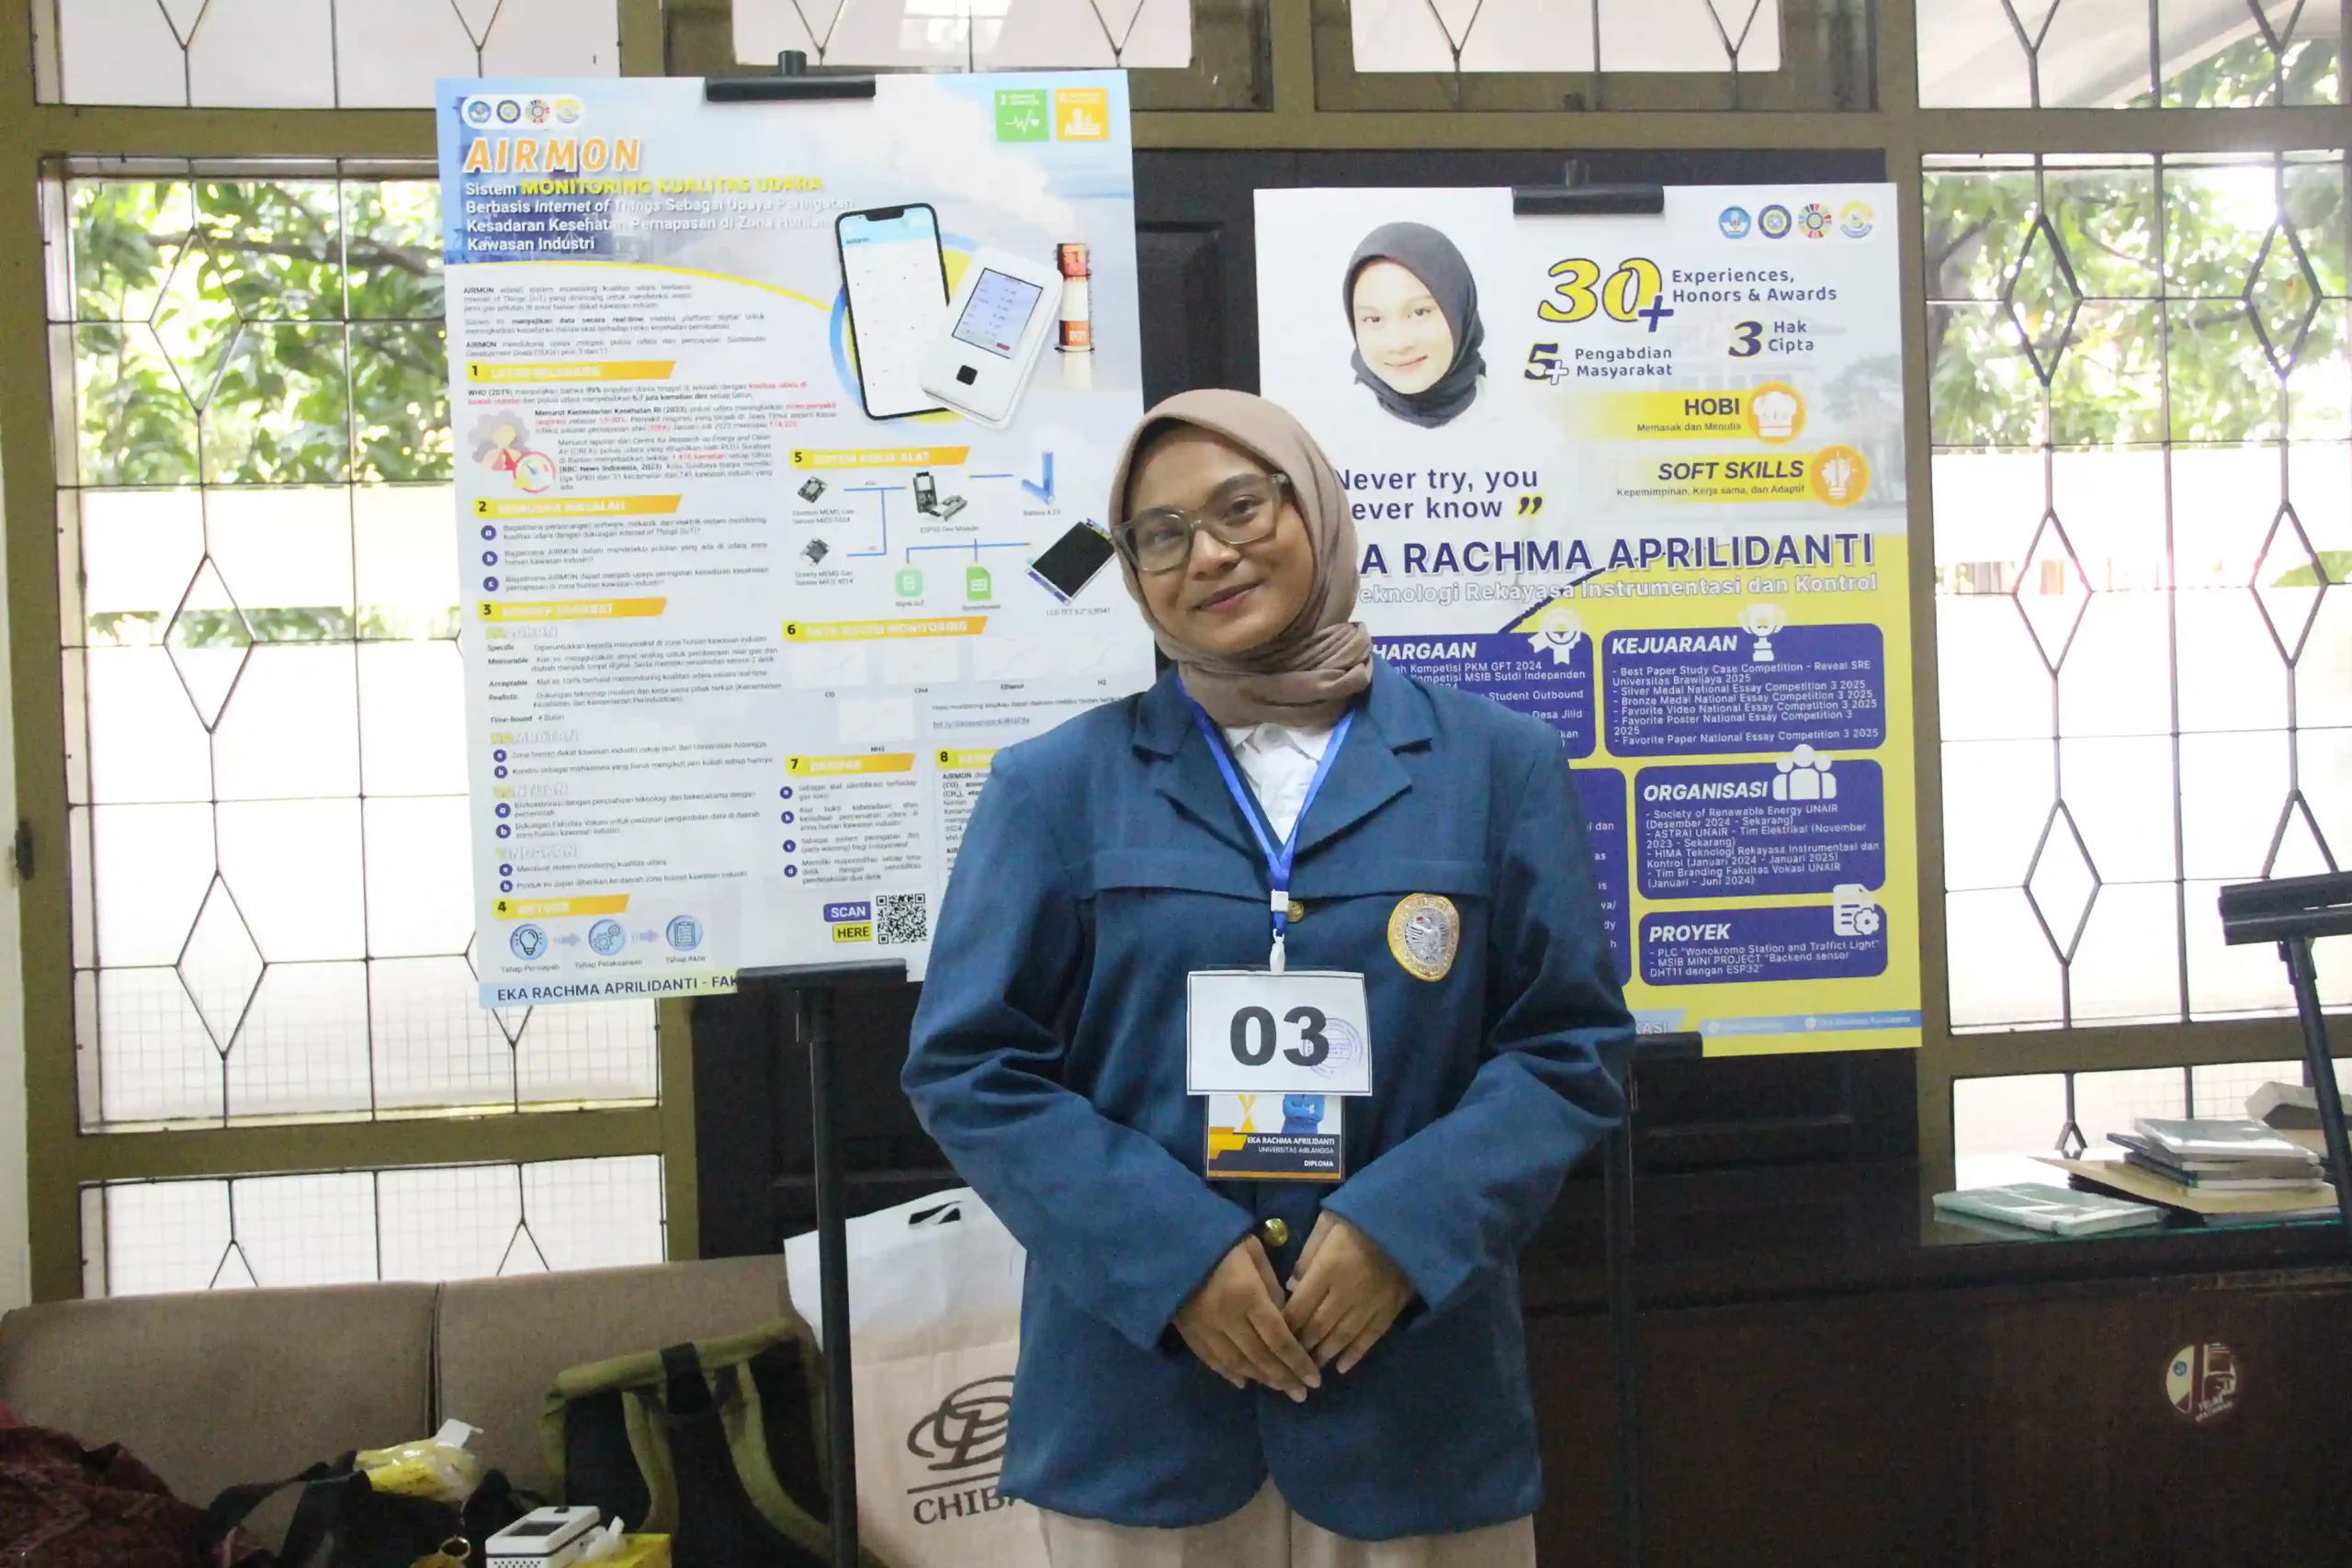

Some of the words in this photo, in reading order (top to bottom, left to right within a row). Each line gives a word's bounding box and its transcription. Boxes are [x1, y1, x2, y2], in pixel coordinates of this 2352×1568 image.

[463, 138, 642, 173] AIRMON
[467, 182, 516, 195] Sistem
[522, 179, 652, 195] MONITORING
[658, 177, 751, 193] KUALITAS
[756, 176, 823, 192] UDARA
[467, 201, 530, 213] Berbasis
[535, 200, 591, 213] Internet
[594, 199, 611, 212] of
[666, 197, 723, 212] Sebagai
[467, 220, 545, 231] Kesadaran
[631, 218, 715, 232] Pernapasan
[468, 239, 534, 251] Kawasan
[539, 237, 594, 250] Industri
[1673, 268, 1794, 284] Experiences,
[1673, 289, 1742, 302] Honors
[1747, 289, 1761, 302] &
[1767, 288, 1837, 301] Awards
[1774, 321, 1807, 333] Hak
[1728, 321, 1762, 357] 3
[1768, 339, 1814, 355] Cipta
[1575, 347, 1672, 362] Pengabdian
[471, 366, 478, 376] 1
[1577, 365, 1673, 379] Masyarakat
[1684, 399, 1739, 415] HOBI
[1637, 423, 1681, 432] Memasak
[1705, 423, 1741, 431] Menulis
[795, 452, 802, 462] 5
[1658, 462, 1719, 479] SOFT
[1724, 460, 1804, 479] SKILLS
[1428, 468, 1474, 494] try,
[1485, 470, 1538, 493] you
[1617, 488, 1690, 497] Kepemimpinan,
[1693, 487, 1717, 496] Kerja
[1720, 487, 1747, 495] sama,
[1751, 486, 1768, 494] dan
[1771, 485, 1804, 493] Adaptif
[479, 502, 487, 512] 2
[1351, 502, 1414, 520] ever
[1426, 497, 1502, 518] know
[1404, 539, 1593, 574] RACHMA
[1609, 533, 1872, 570] APRILIDANTI
[1359, 583, 1459, 604] eknologi
[1466, 582, 1574, 603] Rekayasa
[1581, 577, 1741, 598] Instrumentasi
[1747, 578, 1789, 593] dan
[1795, 574, 1877, 592] Kontrol
[483, 604, 492, 615] 3
[787, 625, 796, 635] 6
[1373, 642, 1476, 660] HARGAAN
[1611, 635, 1737, 654] KEJUARAAN
[1410, 664, 1461, 676] Kompetisi
[1464, 663, 1487, 671] PKM
[1491, 662, 1511, 671] GFT
[1516, 661, 1542, 671] 2024
[1621, 668, 1643, 676] Best
[1647, 668, 1676, 676] Paper
[1680, 666, 1709, 674] Study
[1713, 665, 1737, 673] Case
[1741, 662, 1803, 673] Competition
[1815, 661, 1848, 670] Reveal
[1851, 660, 1871, 670] SRE
[1464, 672, 1491, 682] MSIB
[1494, 672, 1521, 681] Sutdi
[1524, 671, 1585, 682] Independen
[1612, 678, 1669, 686] Universitas
[1674, 676, 1722, 685] Brawijaya
[1726, 674, 1751, 682] 2025
[1734, 684, 1761, 694] Essay
[1766, 682, 1826, 692] Competition
[1831, 681, 1837, 689] 3
[1489, 692, 1529, 701] Student
[1533, 690, 1583, 699] Outbound
[1740, 694, 1769, 703] Essay
[1772, 693, 1834, 702] Competition
[1533, 710, 1558, 719] Desa
[1562, 709, 1582, 718] Jilid
[941, 752, 948, 761] 8
[791, 759, 798, 769] 7
[1644, 782, 1768, 801] ORGANISASI
[1654, 810, 1691, 818] Society
[1695, 809, 1705, 818] of
[1709, 808, 1763, 817] Renewable
[1768, 807, 1802, 816] Energy
[1806, 805, 1838, 813] UNAIR
[1646, 819, 1702, 829] (Desember
[1705, 818, 1730, 827] 2024
[1743, 817, 1793, 826] Sekarang)
[1696, 828, 1727, 837] UNAIR
[1741, 827, 1758, 835] Tim
[1761, 826, 1807, 835] Elektrikal
[1812, 824, 1866, 833] (November
[1687, 848, 1734, 858] Teknologi
[1738, 846, 1785, 856] Rekayasa
[1789, 843, 1858, 853] Instrumentasi
[1860, 842, 1879, 851] dan
[1647, 860, 1682, 868] Kontrol
[1688, 858, 1728, 867] (Januari
[1732, 856, 1756, 864] 2024
[1769, 855, 1805, 863] Januari
[1809, 852, 1838, 863] 2025)
[498, 901, 506, 912] 4
[831, 906, 866, 918] SCAN
[837, 927, 869, 938] HERE
[1649, 923, 1731, 942] PROYEK
[1657, 948, 1677, 957] PLC
[1748, 944, 1784, 954] Station
[1788, 943, 1806, 952] and
[1657, 958, 1684, 967] MSIB
[1687, 956, 1711, 965] MINI
[1713, 954, 1760, 964] PROJECT
[1816, 951, 1849, 960] sensor
[1650, 967, 1682, 977] DHT11
[1685, 966, 1724, 976] dengan
[498, 987, 527, 1001] EKA
[533, 984, 600, 998] RACHMA
[605, 977, 697, 995] APRILIDANTI
[1230, 1006, 1329, 1066] 03
[914, 1484, 1014, 1525] CHIB
